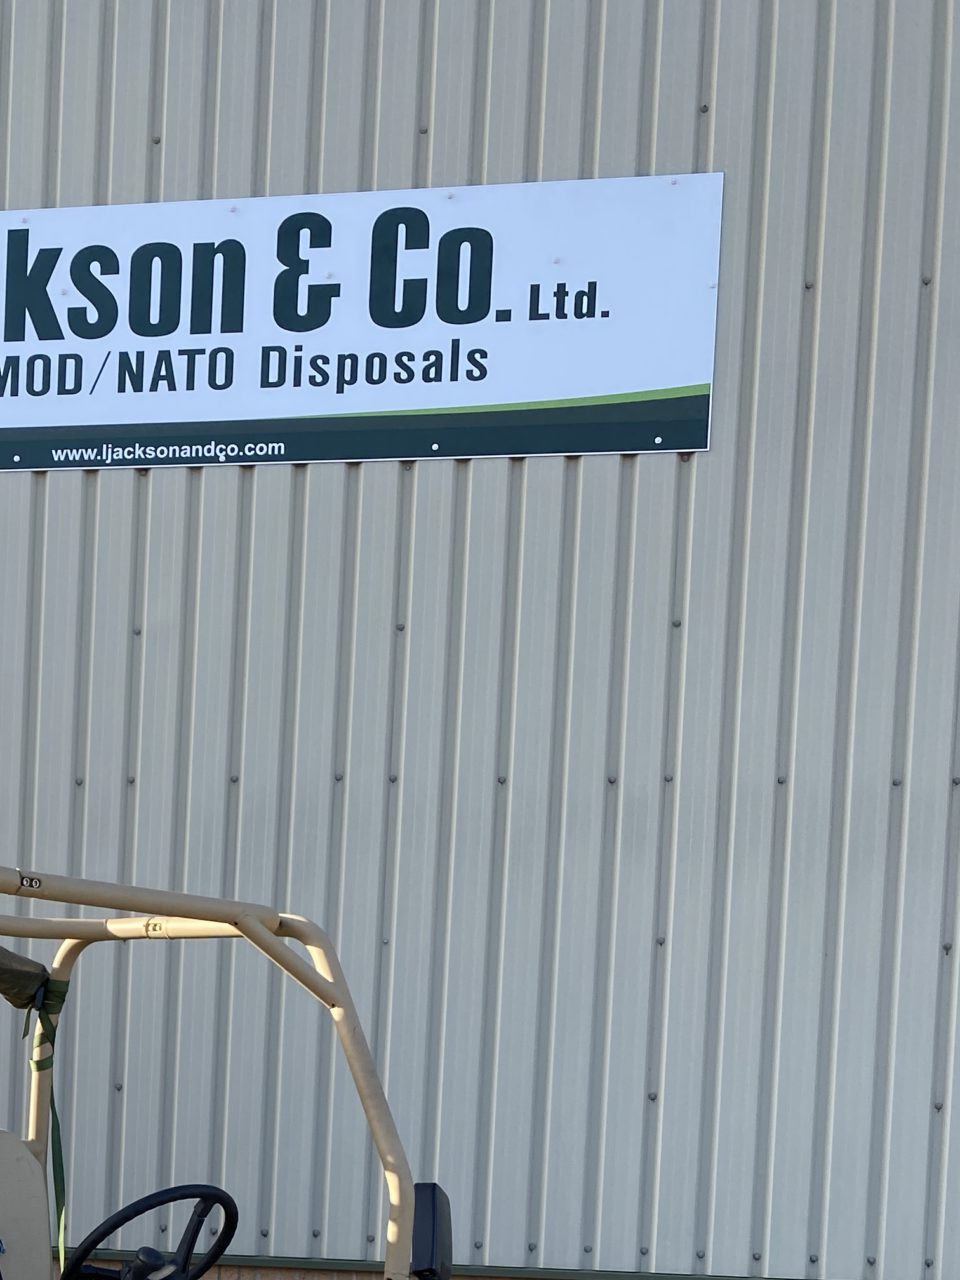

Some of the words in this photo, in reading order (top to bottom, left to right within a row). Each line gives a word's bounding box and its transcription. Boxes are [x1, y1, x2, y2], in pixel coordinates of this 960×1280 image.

[273, 211, 341, 333] &
[368, 206, 512, 328] Co.
[528, 281, 610, 321] Ltd.
[259, 338, 488, 395] Disposals
[51, 440, 286, 463] www.ljacksonandco.com
